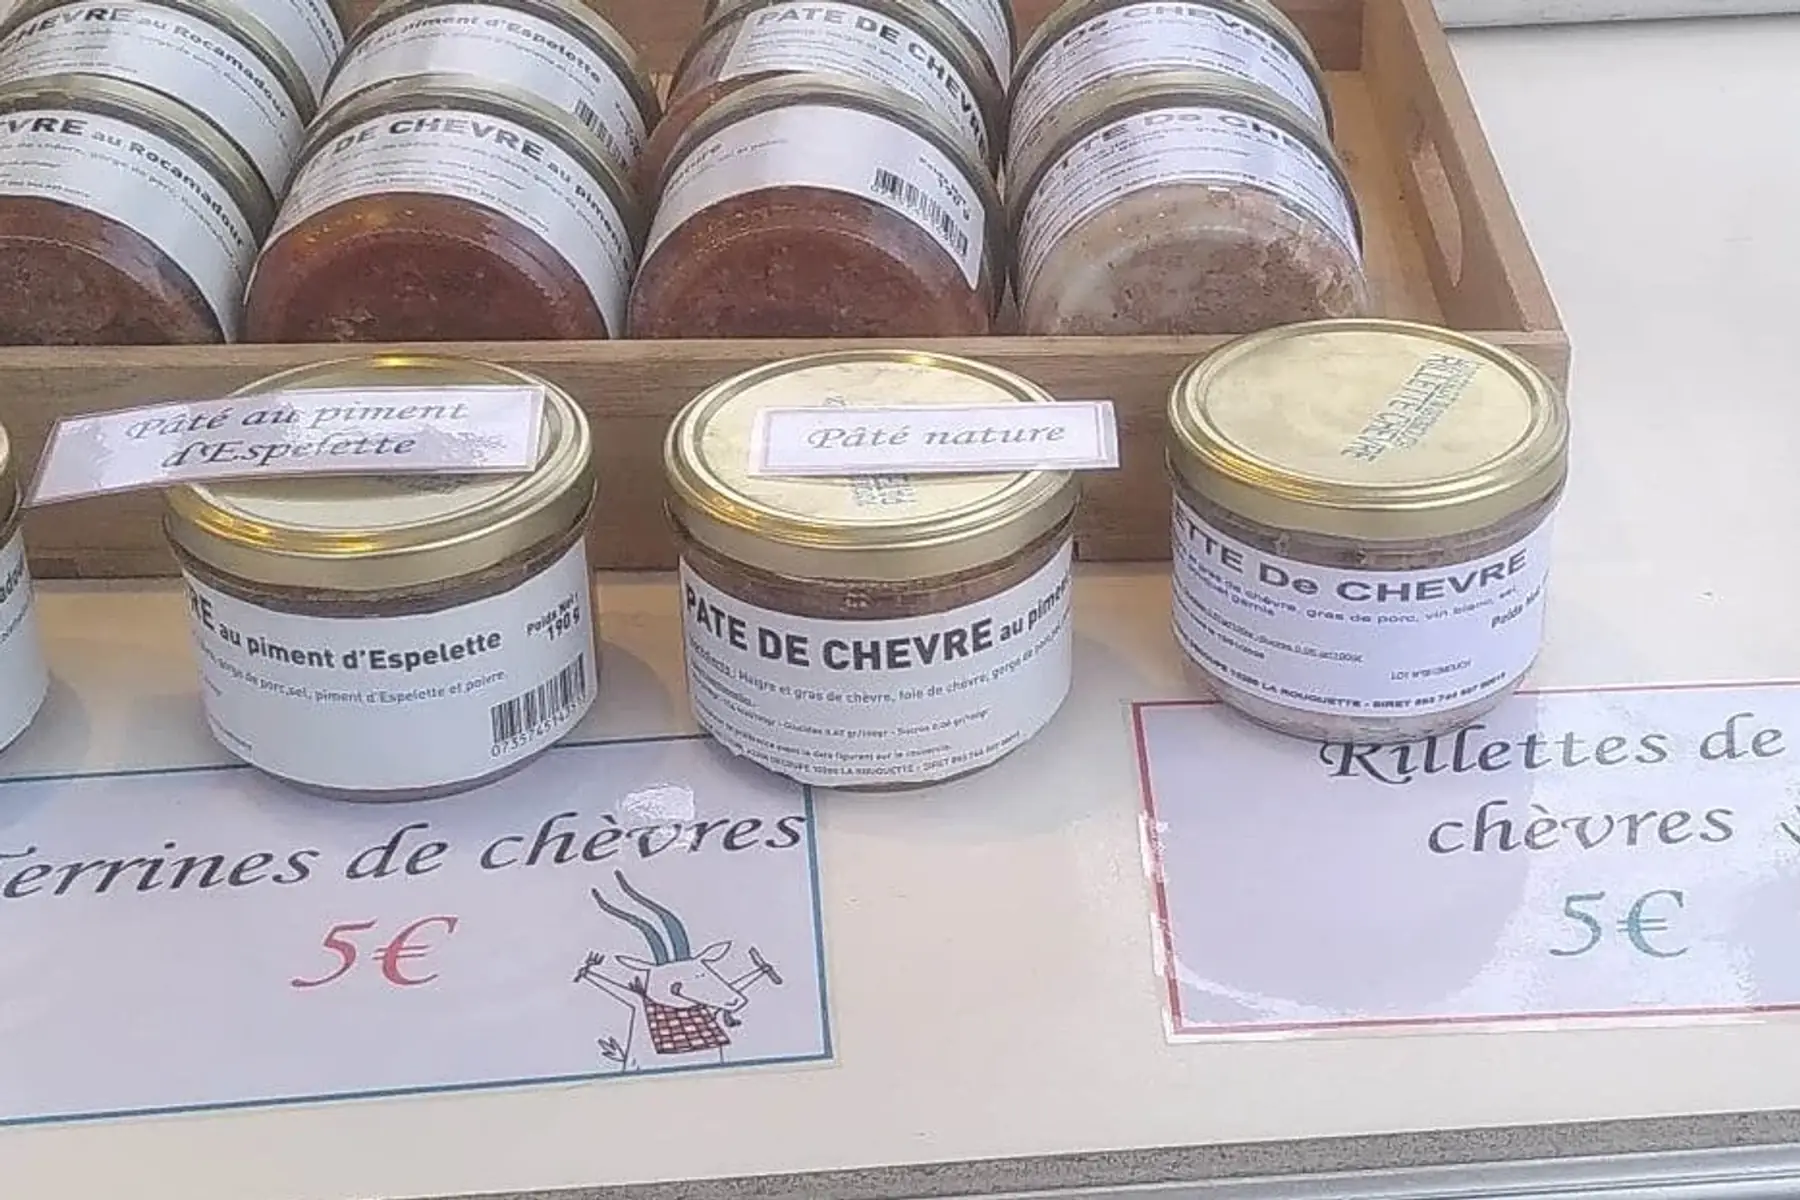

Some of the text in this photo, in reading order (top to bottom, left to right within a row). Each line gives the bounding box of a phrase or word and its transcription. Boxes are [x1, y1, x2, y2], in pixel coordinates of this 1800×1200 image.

[758, 8, 846, 25] PATE
[855, 15, 900, 45] DE
[175, 25, 286, 119] Rocamadour
[388, 117, 544, 162] CHEVRE
[0, 117, 88, 136] VRE
[129, 141, 244, 247] Rocamadour
[126, 407, 234, 439] Pâté
[307, 401, 468, 428] piment
[808, 424, 1065, 449] Pâté nature
[161, 432, 416, 467] d'Espelette
[1260, 563, 1319, 595] De
[1337, 548, 1527, 602] CHEVRE
[548, 611, 570, 641] 190
[686, 583, 748, 651] PATE
[758, 627, 810, 667] DE
[823, 618, 993, 671] CHEVRE
[1000, 617, 1023, 641] au
[1306, 609, 1344, 620] gras
[1350, 612, 1371, 622] de
[219, 623, 241, 646] au
[247, 637, 335, 669] piment
[342, 632, 501, 672] d'Espelette
[315, 688, 363, 704] piment
[449, 681, 462, 695] et
[927, 683, 943, 697] de
[1320, 712, 1786, 785] Rillettes de
[345, 823, 448, 881] de
[480, 812, 806, 871] chèvres
[1429, 800, 1735, 854] chèvres
[1550, 889, 1689, 959] 5€
[291, 914, 458, 988] 5€
